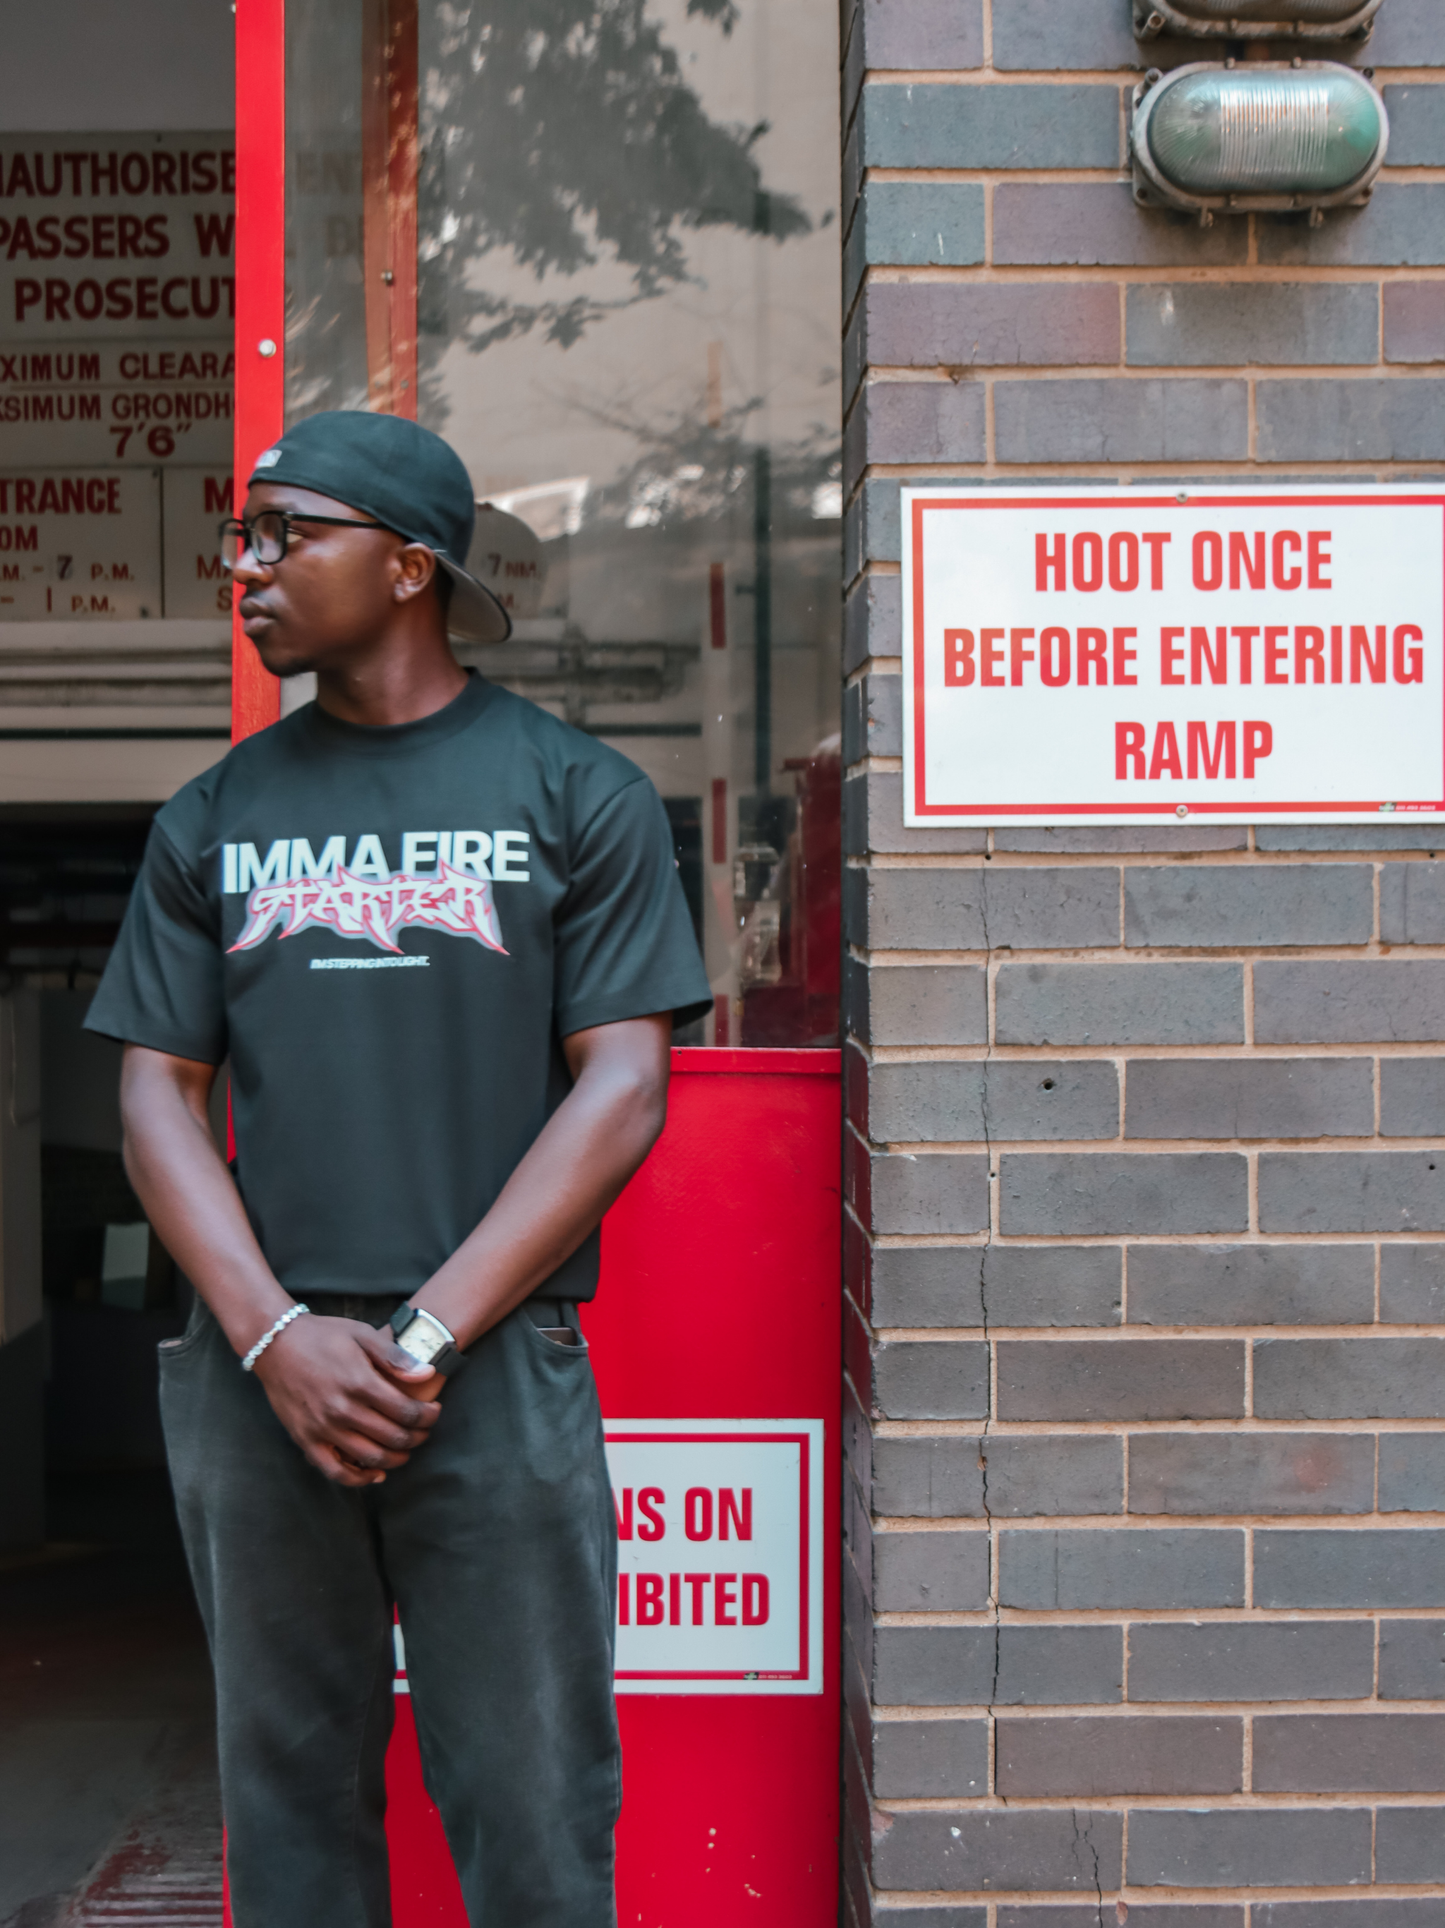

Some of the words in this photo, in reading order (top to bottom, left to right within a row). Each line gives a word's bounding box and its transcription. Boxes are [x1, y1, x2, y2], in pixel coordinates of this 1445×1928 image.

[0, 393, 101, 423] SIMUM
[111, 391, 235, 421] GRONDH
[1035, 531, 1172, 592] HOOT
[1192, 530, 1333, 591] ONCE
[944, 626, 1138, 688] BEFORE
[1160, 623, 1424, 686] ENTERING
[1115, 720, 1274, 781] RAMP
[222, 834, 391, 894] IMMA
[402, 829, 531, 883] FIRE
[226, 857, 510, 955] STARTER
[684, 1486, 753, 1542] ON
[618, 1572, 770, 1627] IBITED
